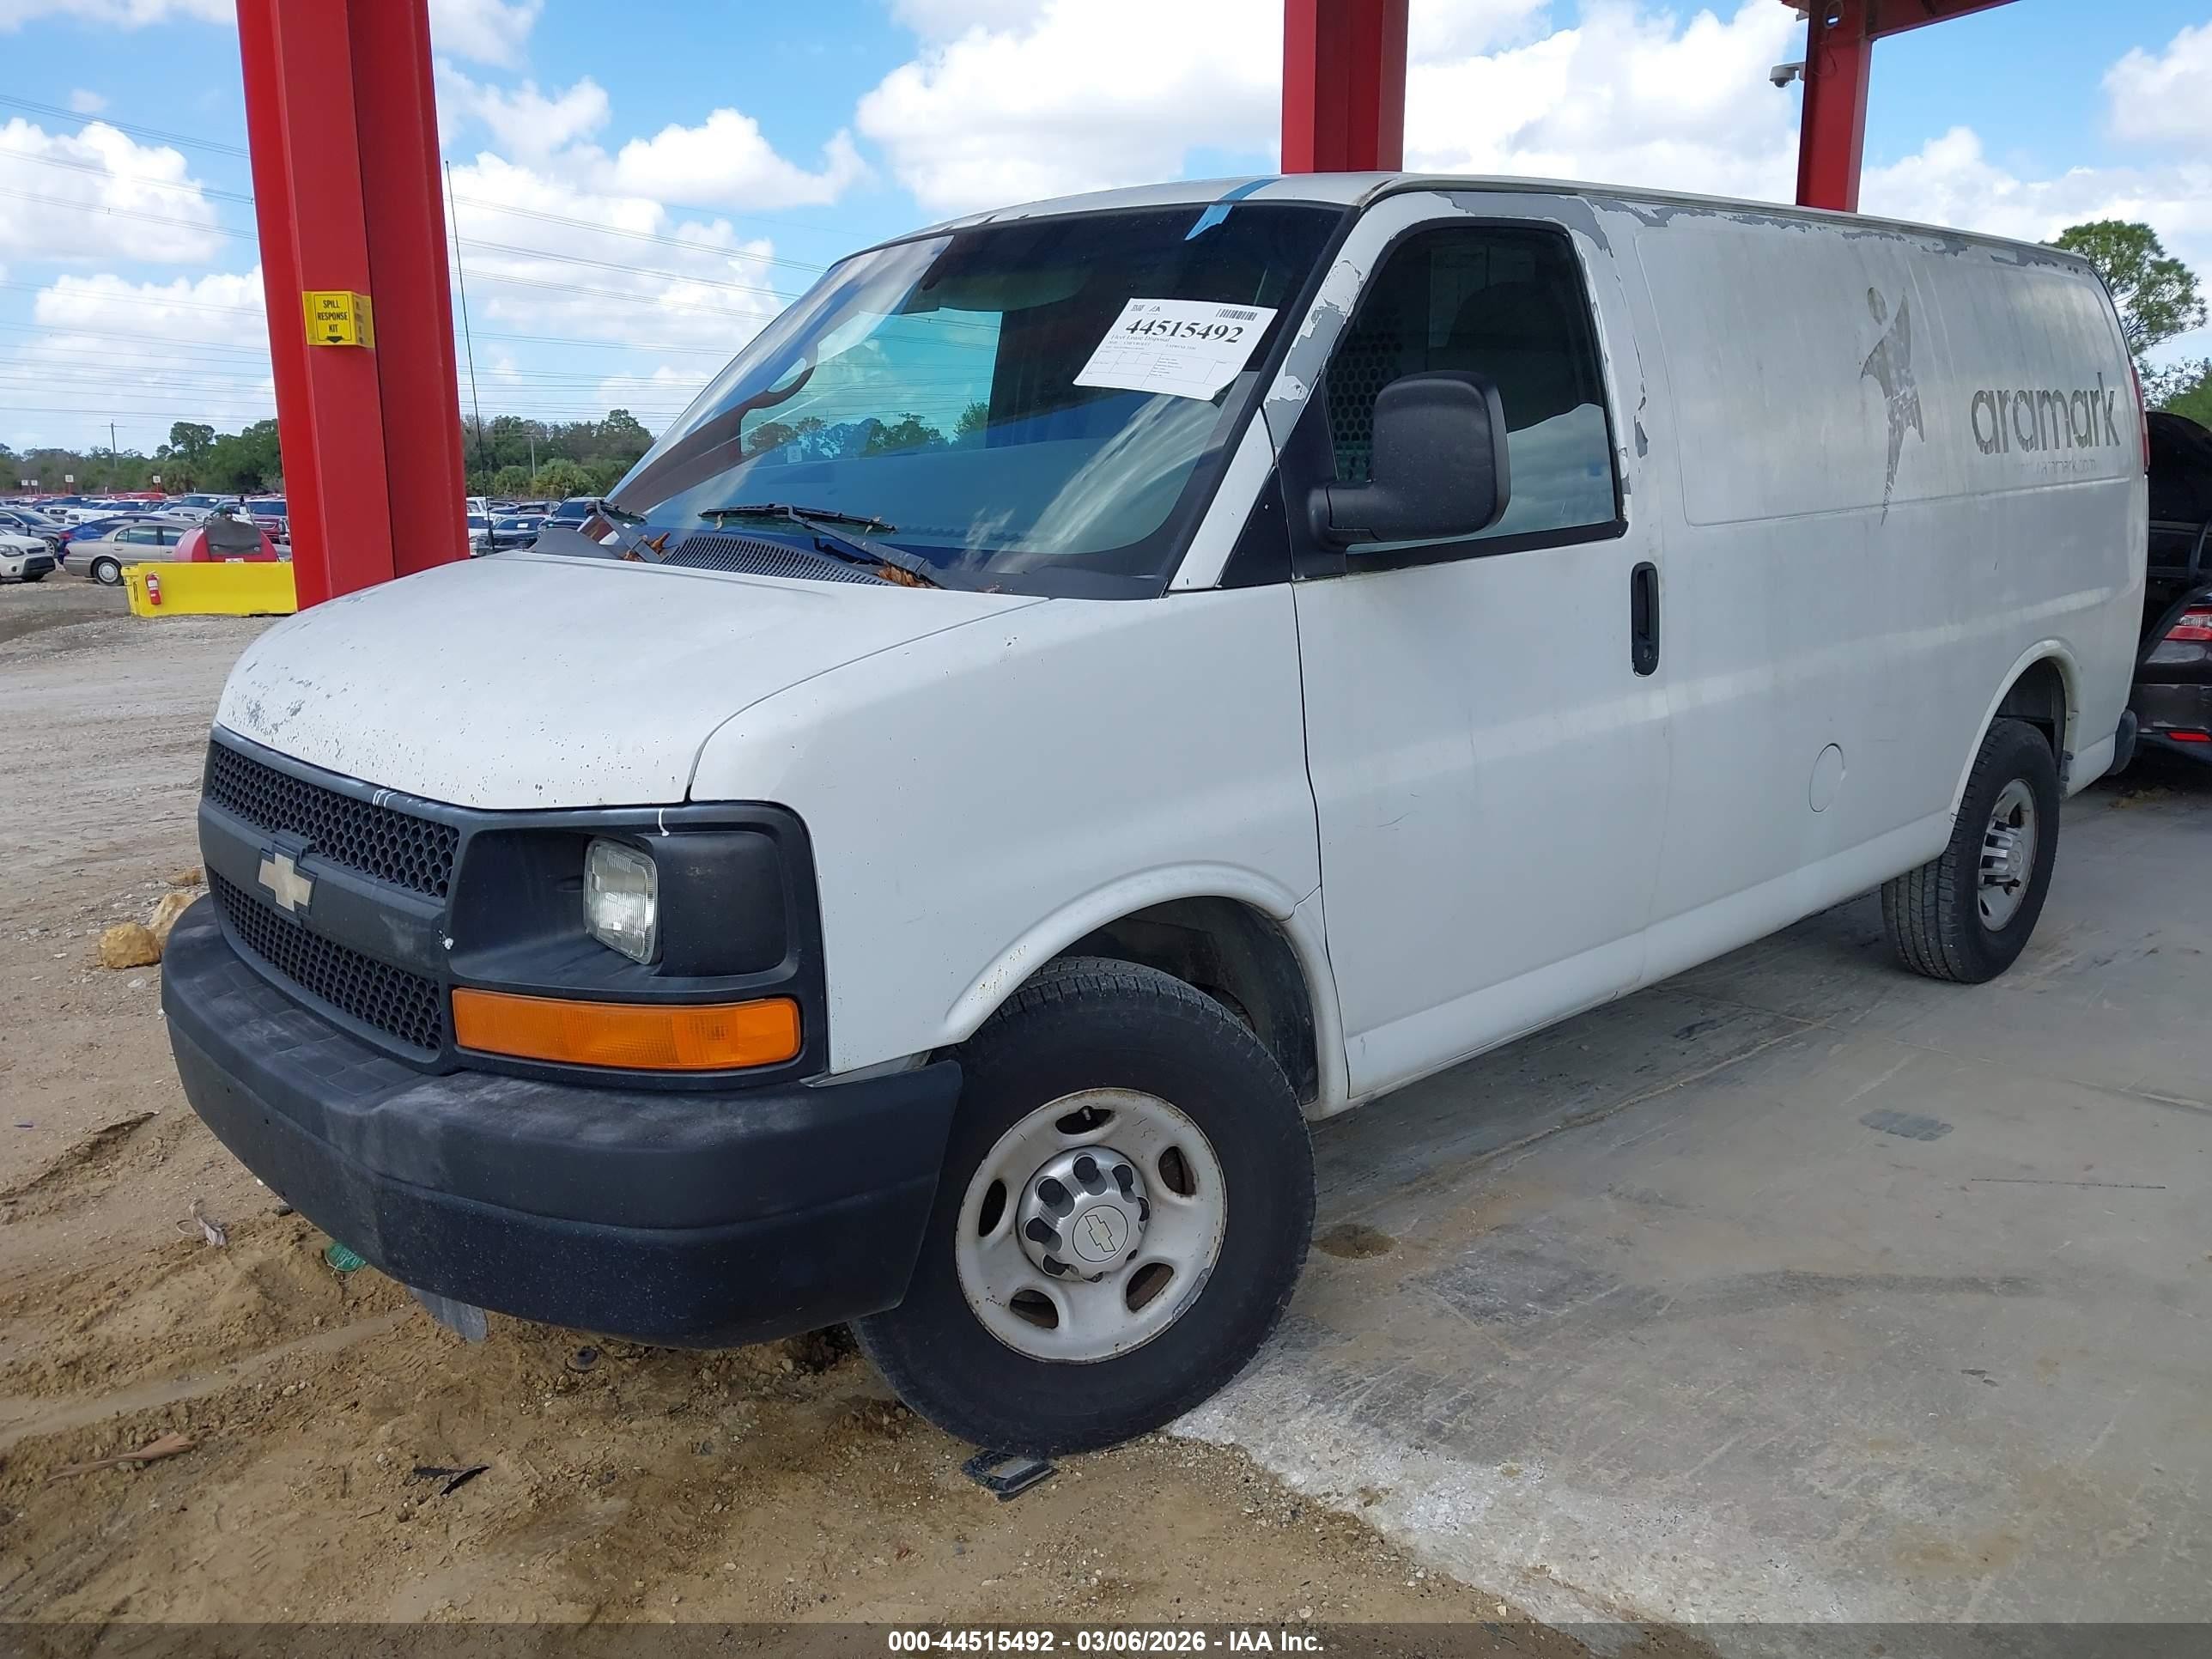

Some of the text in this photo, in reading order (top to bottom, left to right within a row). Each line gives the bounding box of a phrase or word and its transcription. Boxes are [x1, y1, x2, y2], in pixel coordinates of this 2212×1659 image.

[323, 300, 340, 309] SPILL
[317, 312, 349, 321] RESPONSE
[328, 324, 339, 333] KIT
[1125, 318, 1244, 343] 44515492
[1971, 371, 2121, 455] aramark
